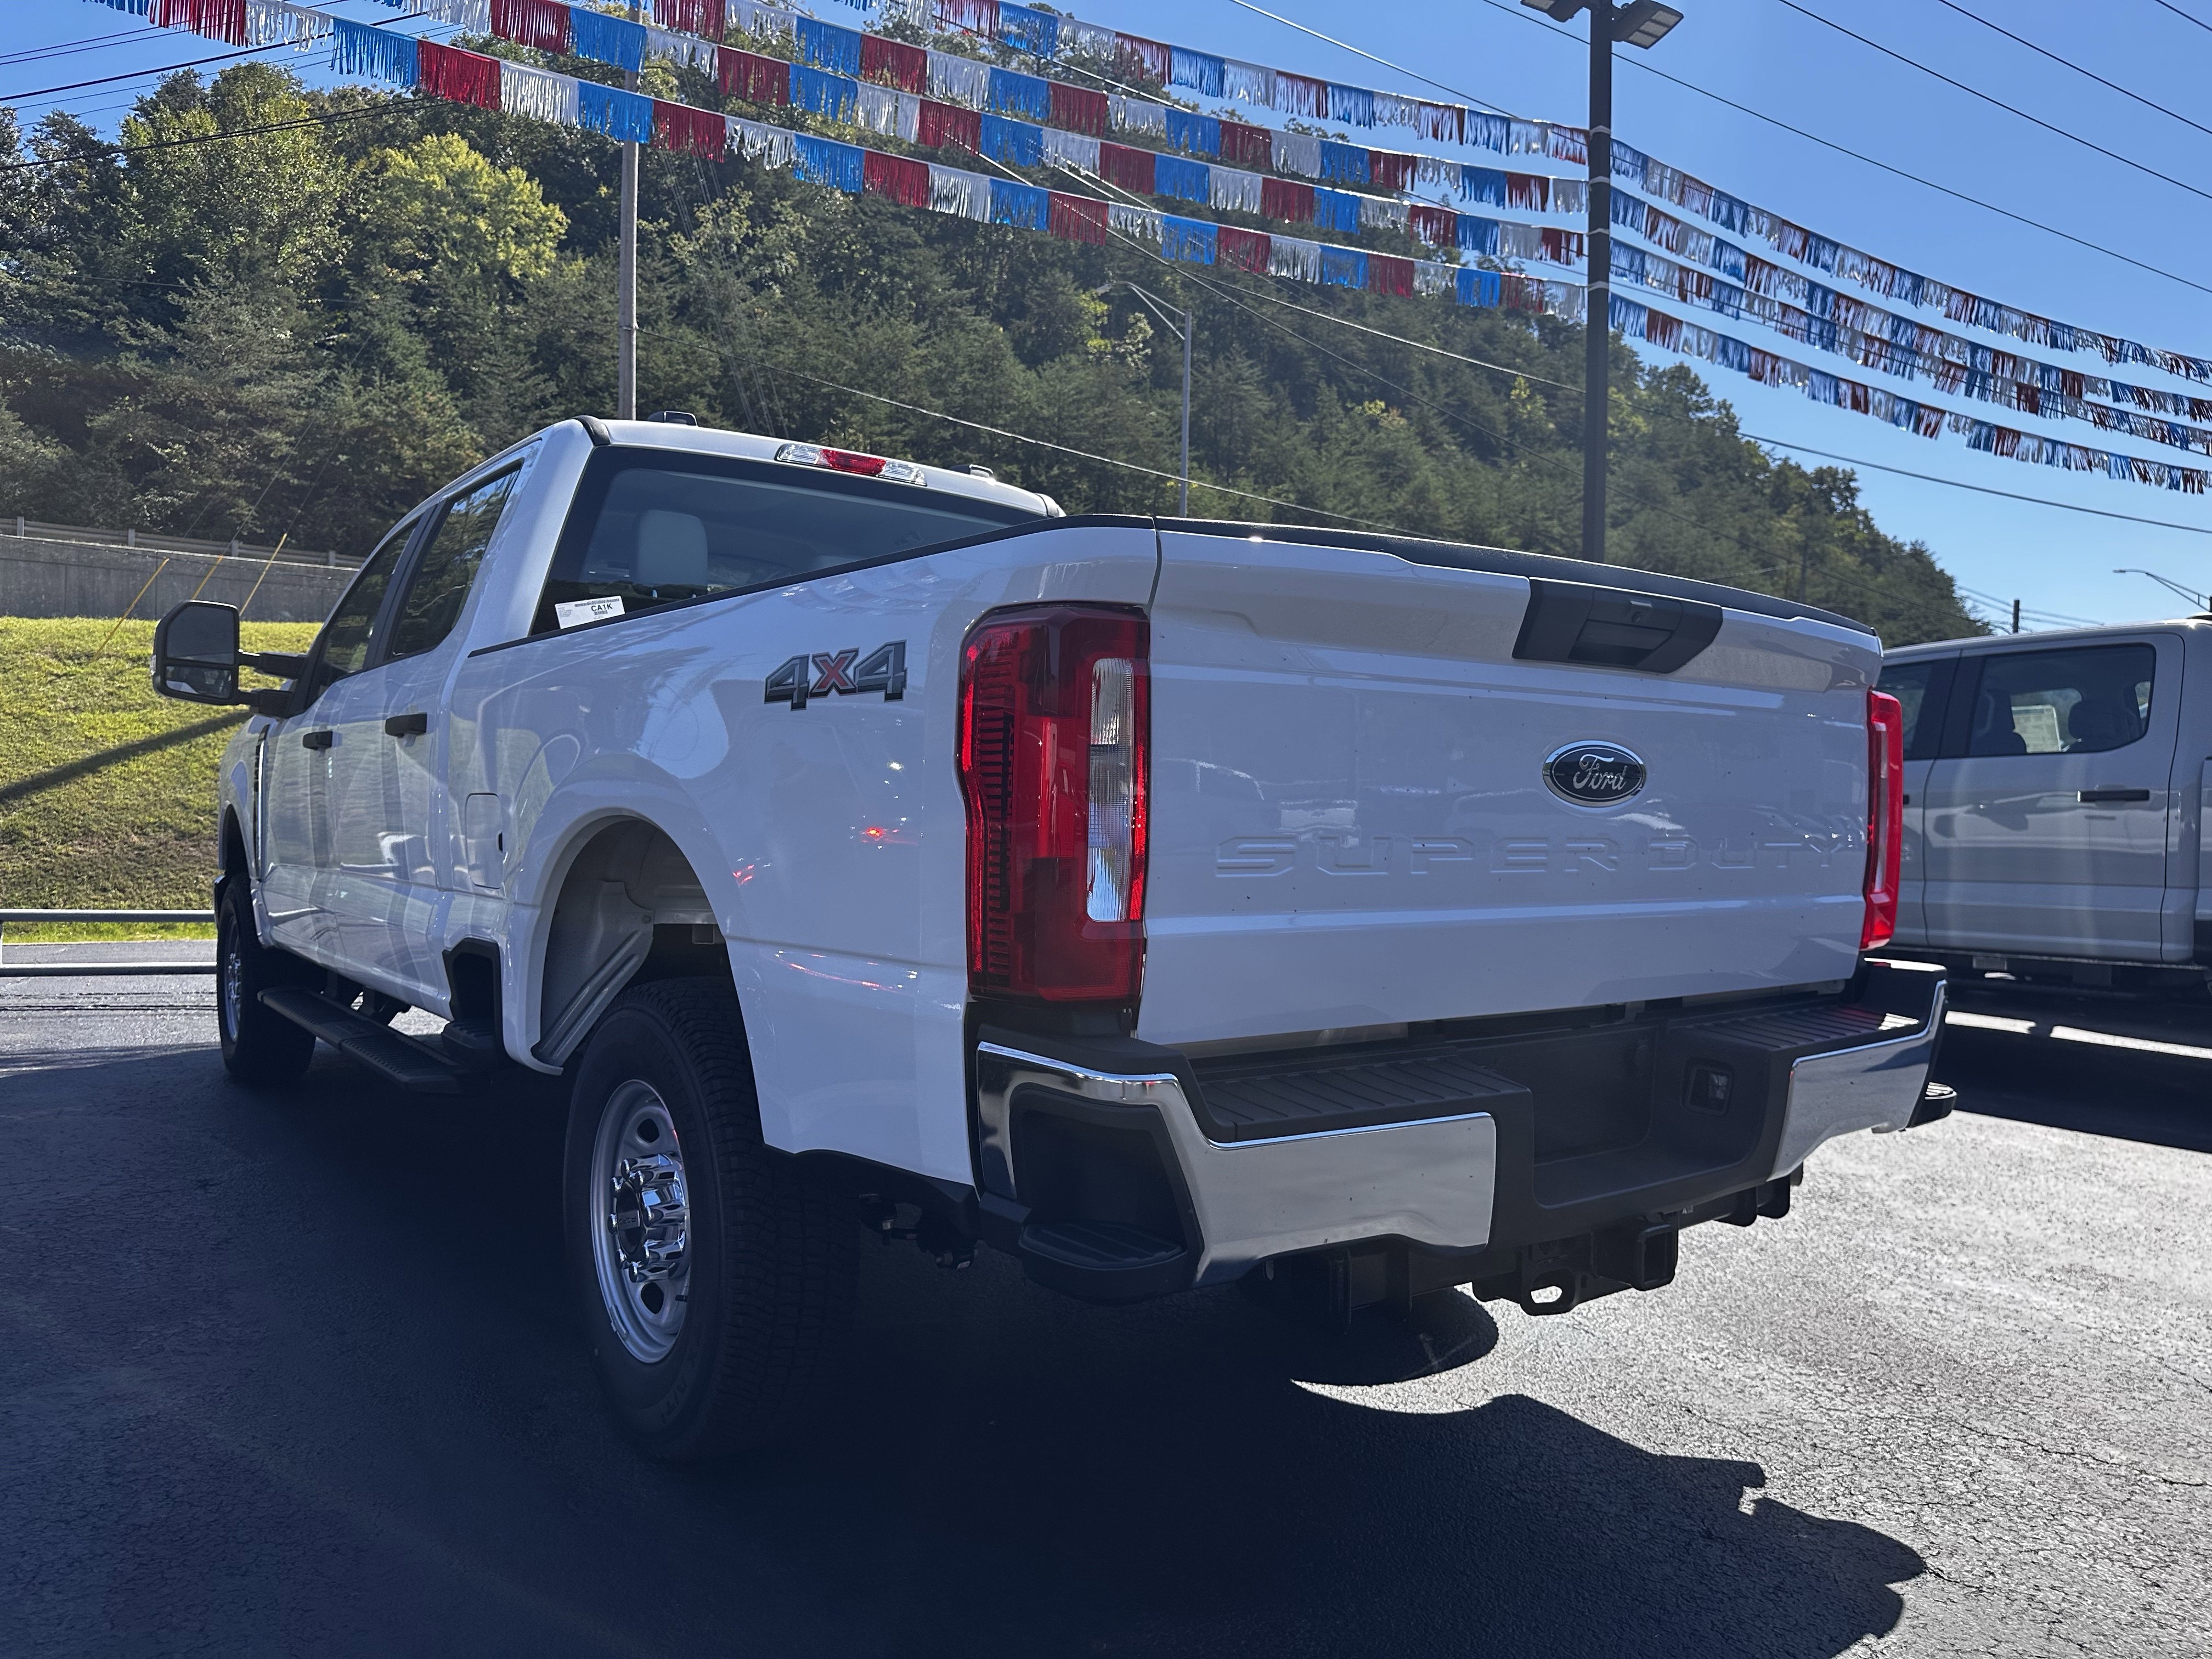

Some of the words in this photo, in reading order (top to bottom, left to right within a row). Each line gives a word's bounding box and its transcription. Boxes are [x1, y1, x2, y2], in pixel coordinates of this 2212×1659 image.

[591, 603, 613, 612] CA1K
[1573, 754, 1628, 791] Ford
[1215, 835, 1620, 877] SUPER
[1647, 834, 1849, 871] DUTY
